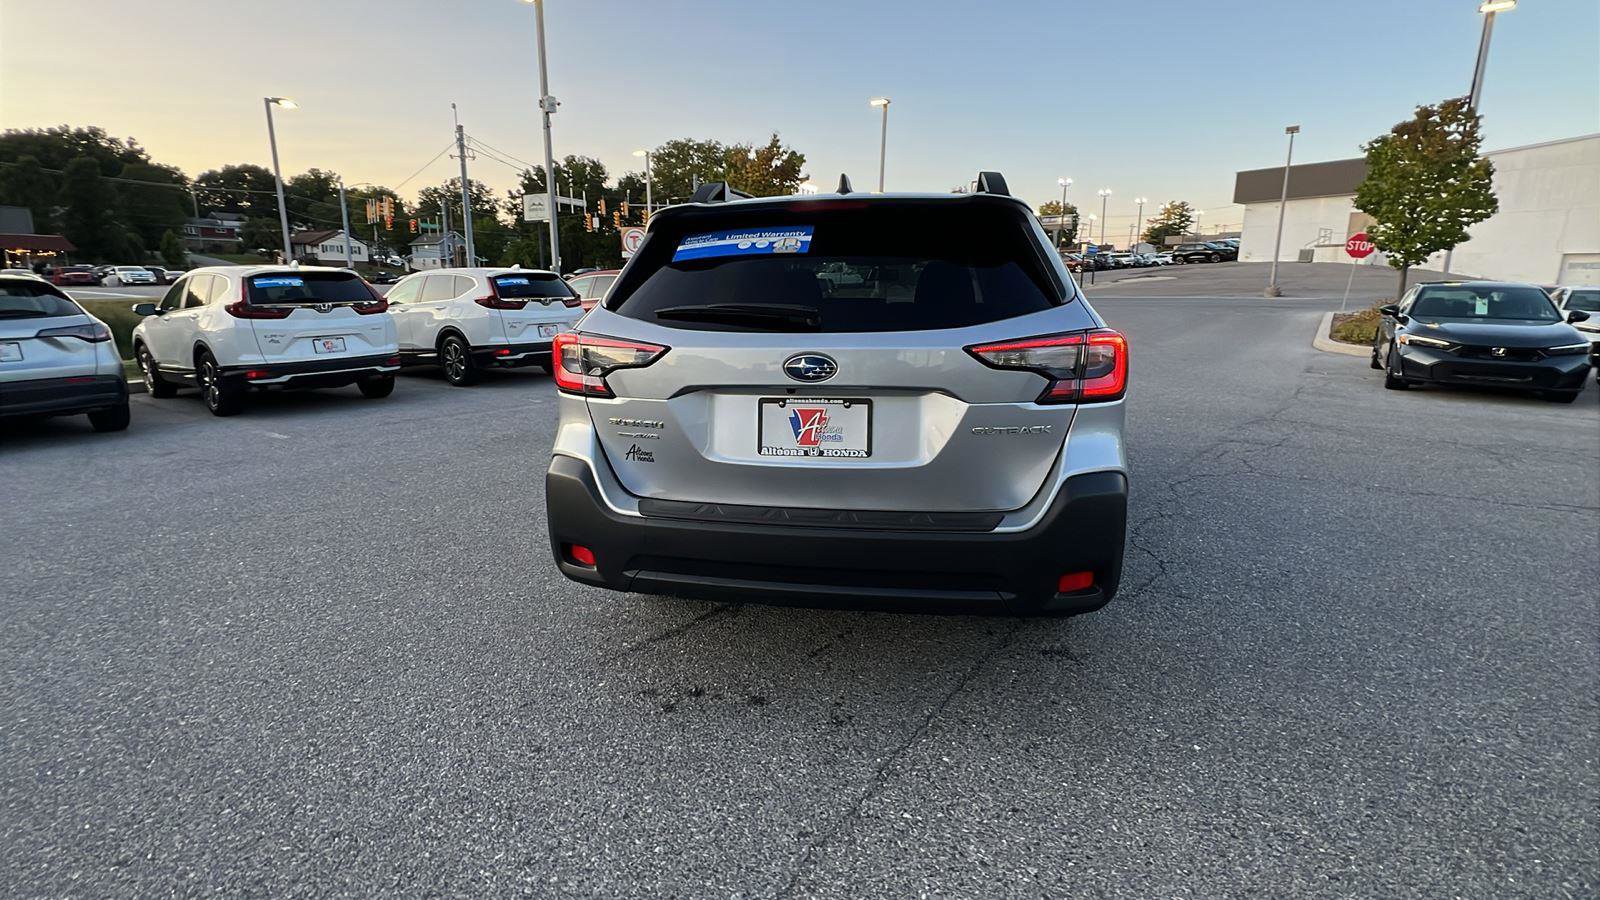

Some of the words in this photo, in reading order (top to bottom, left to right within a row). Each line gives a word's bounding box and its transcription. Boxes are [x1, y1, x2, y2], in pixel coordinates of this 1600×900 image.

[725, 232, 761, 241] Limited
[761, 230, 806, 238] Warranty
[1346, 239, 1375, 251] STOP
[971, 425, 1052, 435] OUTBACK
[816, 433, 843, 442] Honda
[760, 447, 805, 456] Altoona
[823, 448, 868, 457] HONDA
